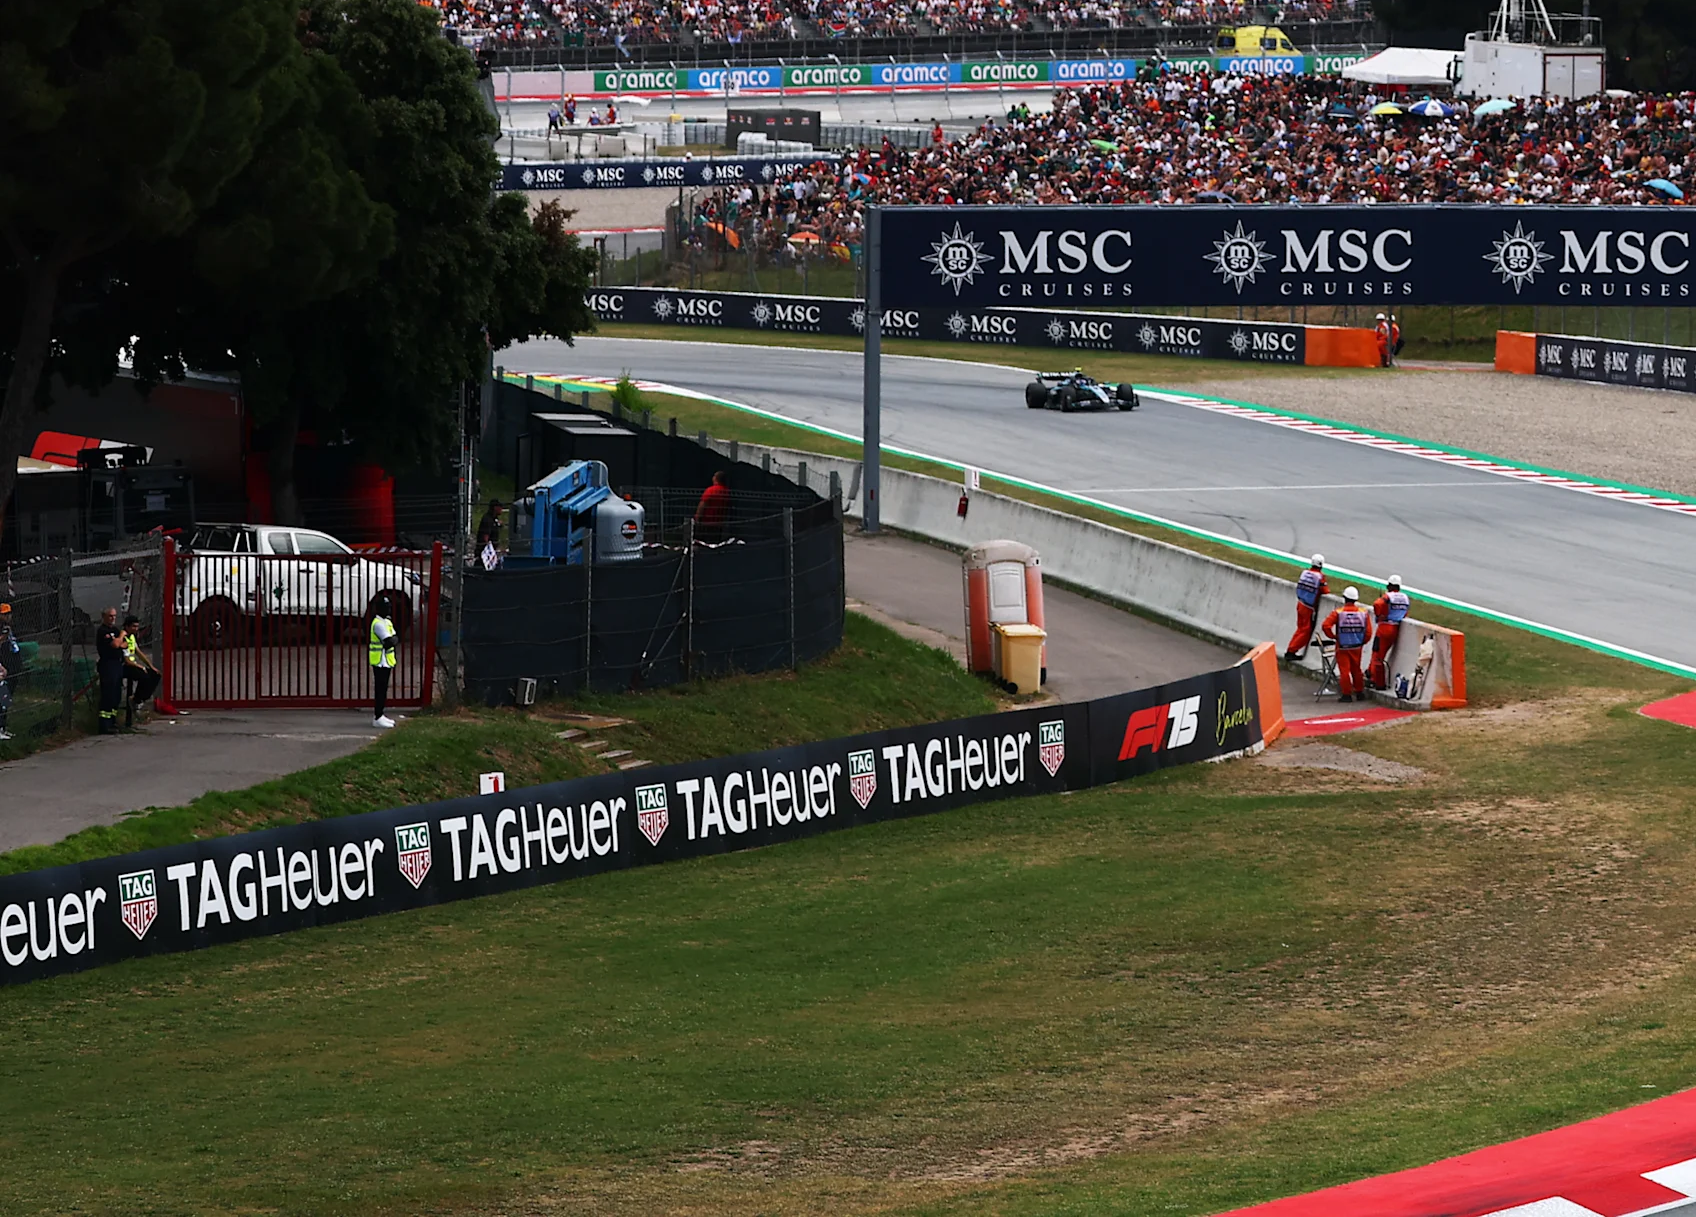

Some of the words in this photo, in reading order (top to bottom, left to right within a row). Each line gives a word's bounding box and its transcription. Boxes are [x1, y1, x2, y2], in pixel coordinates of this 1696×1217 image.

[881, 66, 949, 83] aramco
[971, 64, 1038, 80] aramco
[1058, 62, 1125, 78] aramco
[1229, 56, 1294, 73] aramco
[1315, 57, 1364, 72] aram
[605, 71, 677, 89] aramco
[699, 70, 770, 87] aramco
[791, 68, 861, 84] aramco
[535, 168, 565, 182] MSC
[596, 167, 625, 181] MSC
[656, 166, 685, 180] MSC
[716, 165, 744, 179] MSC
[999, 230, 1133, 275] MSC
[1281, 230, 1413, 273] MSC
[1559, 230, 1690, 275] MSC
[999, 283, 1133, 297] CRUISES
[1281, 282, 1413, 295] CRUISES
[1559, 283, 1690, 297] CRUISES
[583, 294, 624, 312] MSC
[677, 298, 723, 317] MSC
[775, 304, 820, 323] MSC
[970, 315, 1016, 333] MSC
[1069, 320, 1113, 340] MSC
[1159, 325, 1201, 346] MSC
[1252, 332, 1296, 351] MSC
[1547, 344, 1562, 364] MSC
[1580, 348, 1596, 368] MSC
[1612, 351, 1629, 371] MSC
[1670, 357, 1686, 377] MSC
[1041, 723, 1063, 743] TAG
[851, 754, 874, 774] TAG
[883, 731, 1031, 804] TAGHeuer
[1040, 745, 1064, 774] HEUER
[638, 788, 664, 810] TAG
[851, 775, 876, 806] HEUER
[675, 762, 841, 841] TAGHeuer
[638, 811, 668, 842] HEUER
[399, 828, 428, 850] TAG
[441, 796, 626, 882] TAGHeuer
[400, 852, 430, 885] HEUER
[122, 875, 153, 899] TAG
[167, 837, 385, 931] TAGHeuer
[0, 887, 107, 966] euer
[123, 899, 156, 934] HEUER
